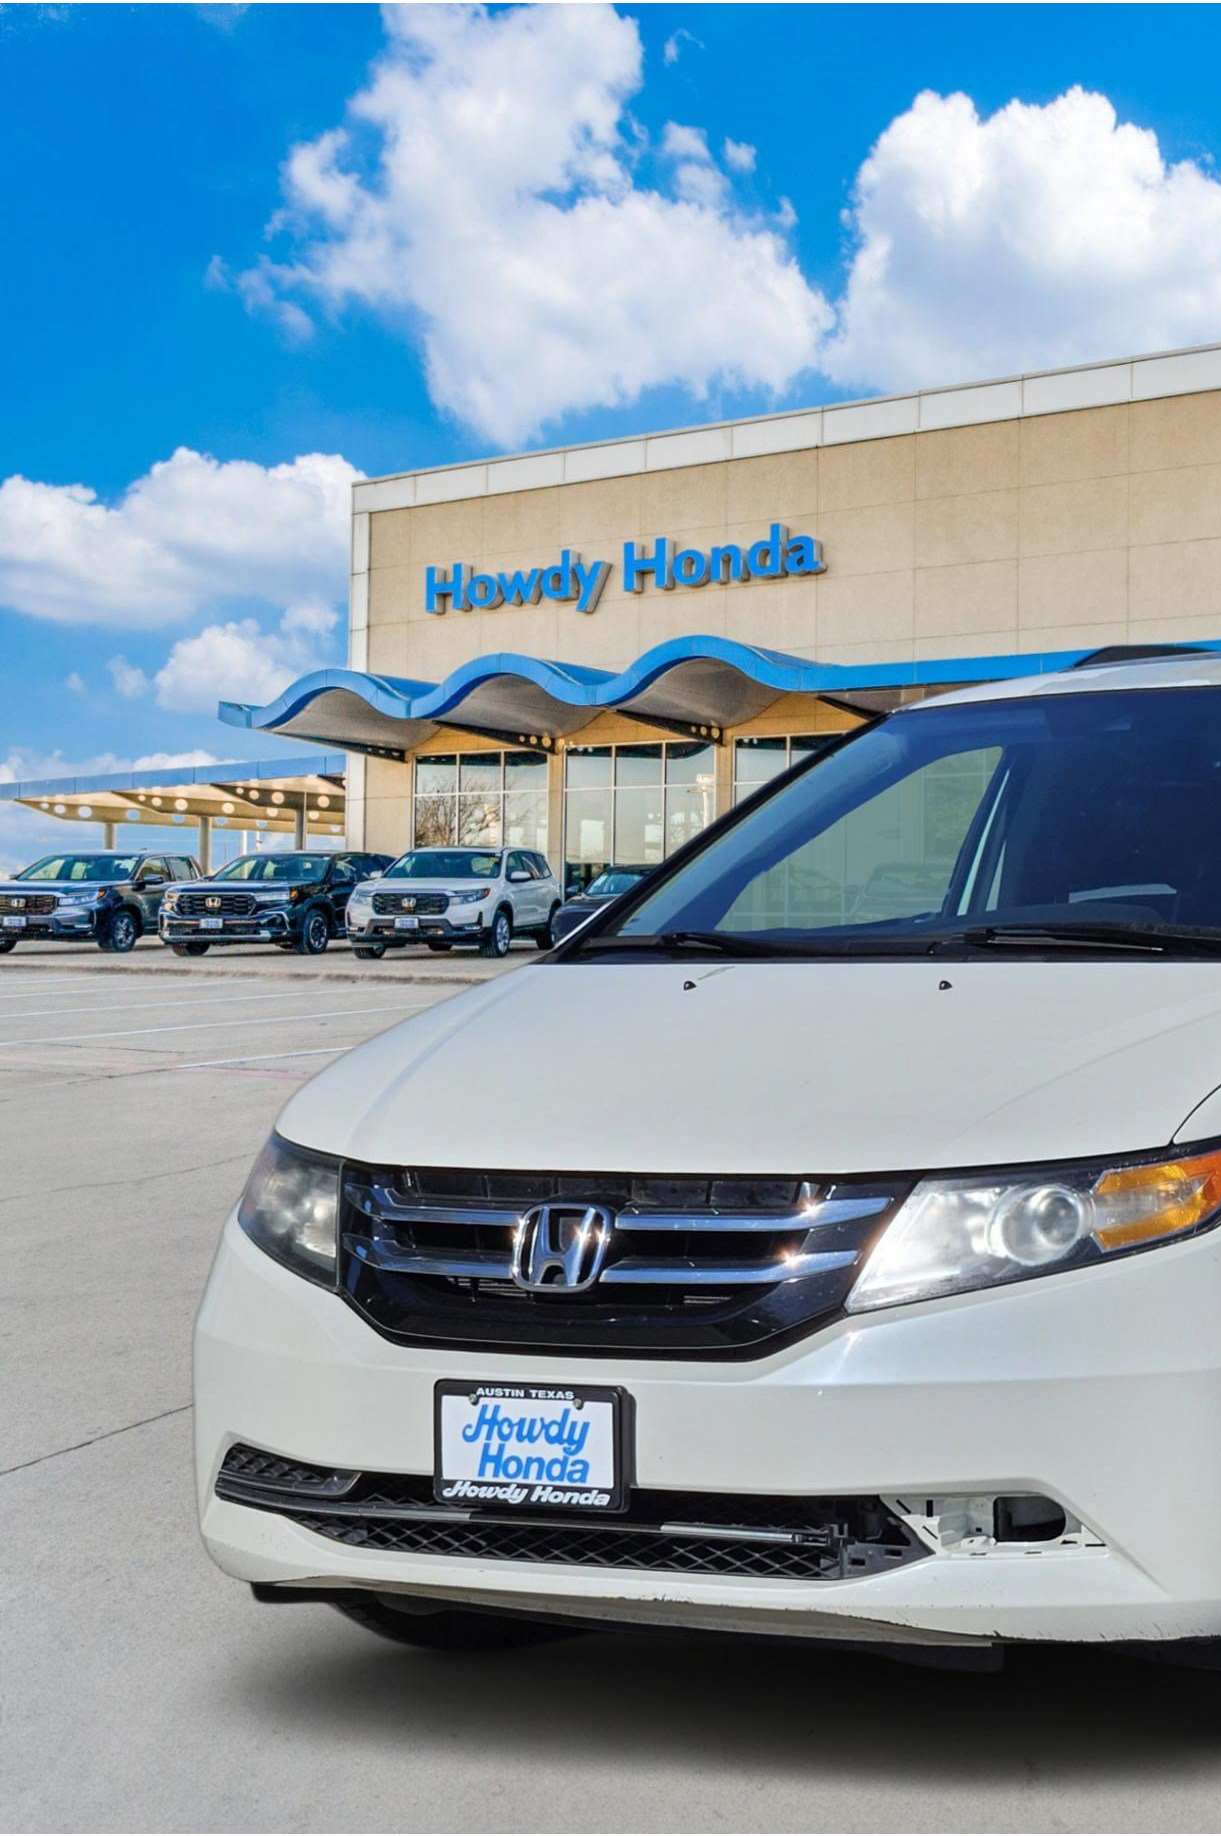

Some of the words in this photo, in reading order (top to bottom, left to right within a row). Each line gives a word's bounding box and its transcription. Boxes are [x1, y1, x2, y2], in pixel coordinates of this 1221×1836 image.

[424, 548, 611, 615] Howdy
[622, 522, 827, 594] Honda
[475, 1386, 525, 1398] AUSTIN
[529, 1388, 576, 1400] TEXAS
[462, 1403, 591, 1456] Howdy
[477, 1442, 591, 1484] Honda
[442, 1480, 529, 1505] Howdy
[530, 1485, 611, 1507] Honda
